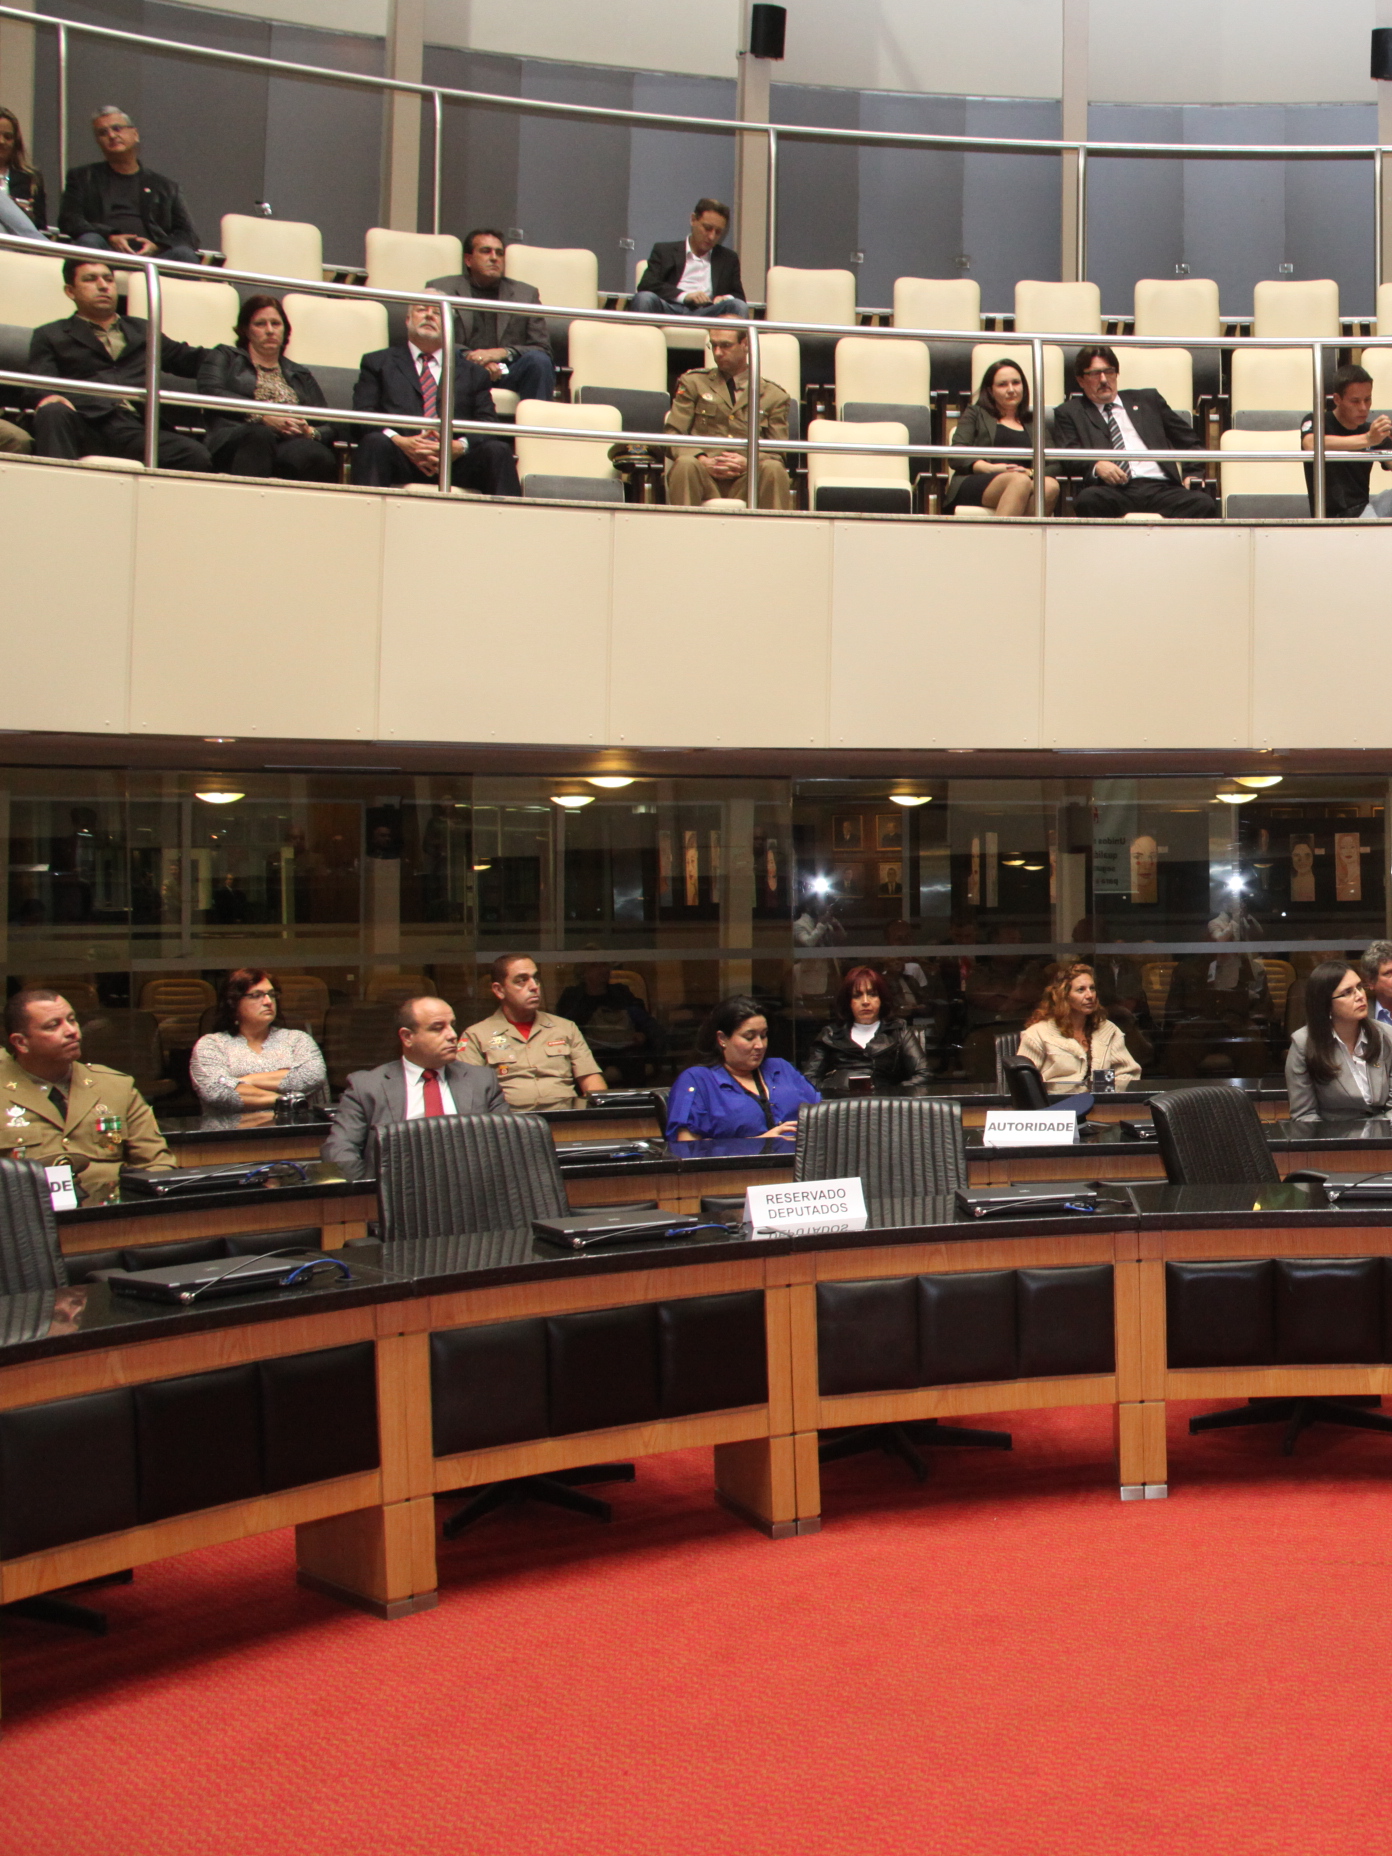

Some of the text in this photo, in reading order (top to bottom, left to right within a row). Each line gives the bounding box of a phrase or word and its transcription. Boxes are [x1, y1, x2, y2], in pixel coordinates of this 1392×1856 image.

[987, 1122, 1073, 1132] AUTORIDADE
[765, 1188, 846, 1205] RESERVADO
[768, 1202, 848, 1219] DEPUTADOS
